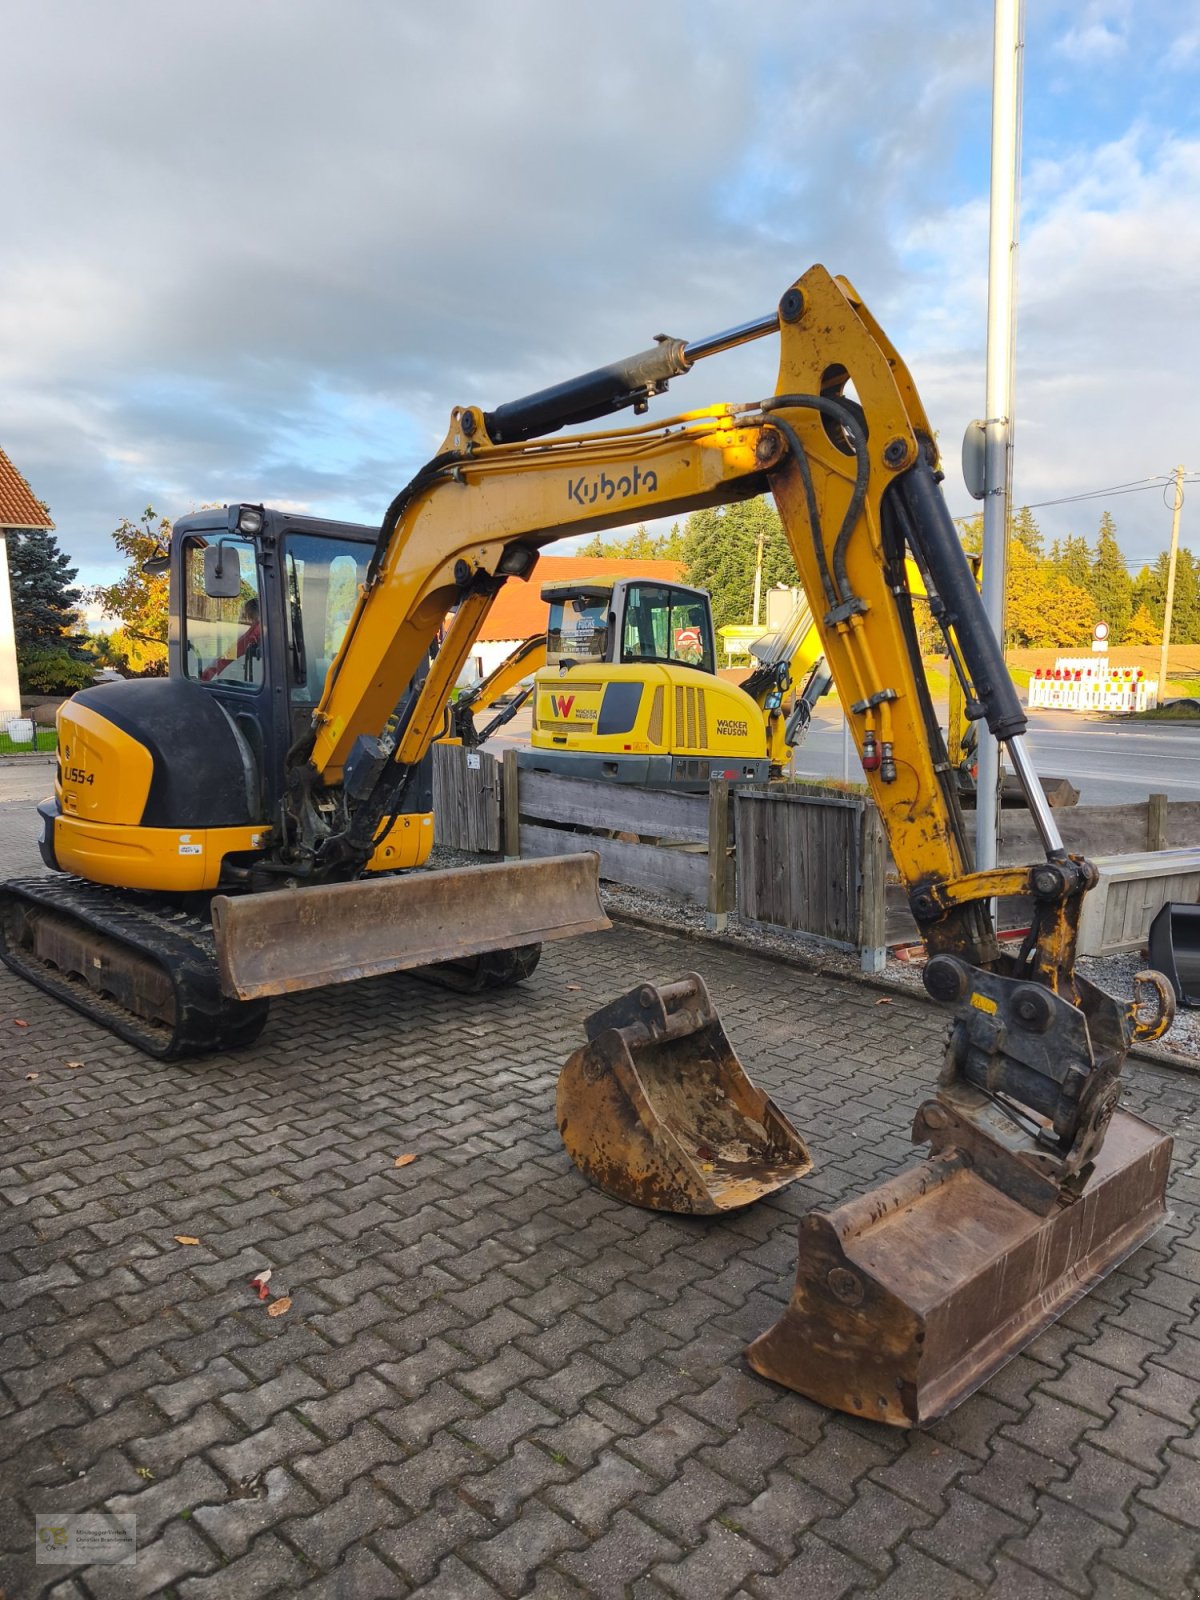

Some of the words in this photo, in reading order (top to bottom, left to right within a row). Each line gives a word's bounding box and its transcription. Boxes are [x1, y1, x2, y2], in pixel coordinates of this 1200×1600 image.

[568, 465, 658, 504] Kubota
[717, 719, 748, 729] WACKER
[717, 727, 748, 736] NEUSON
